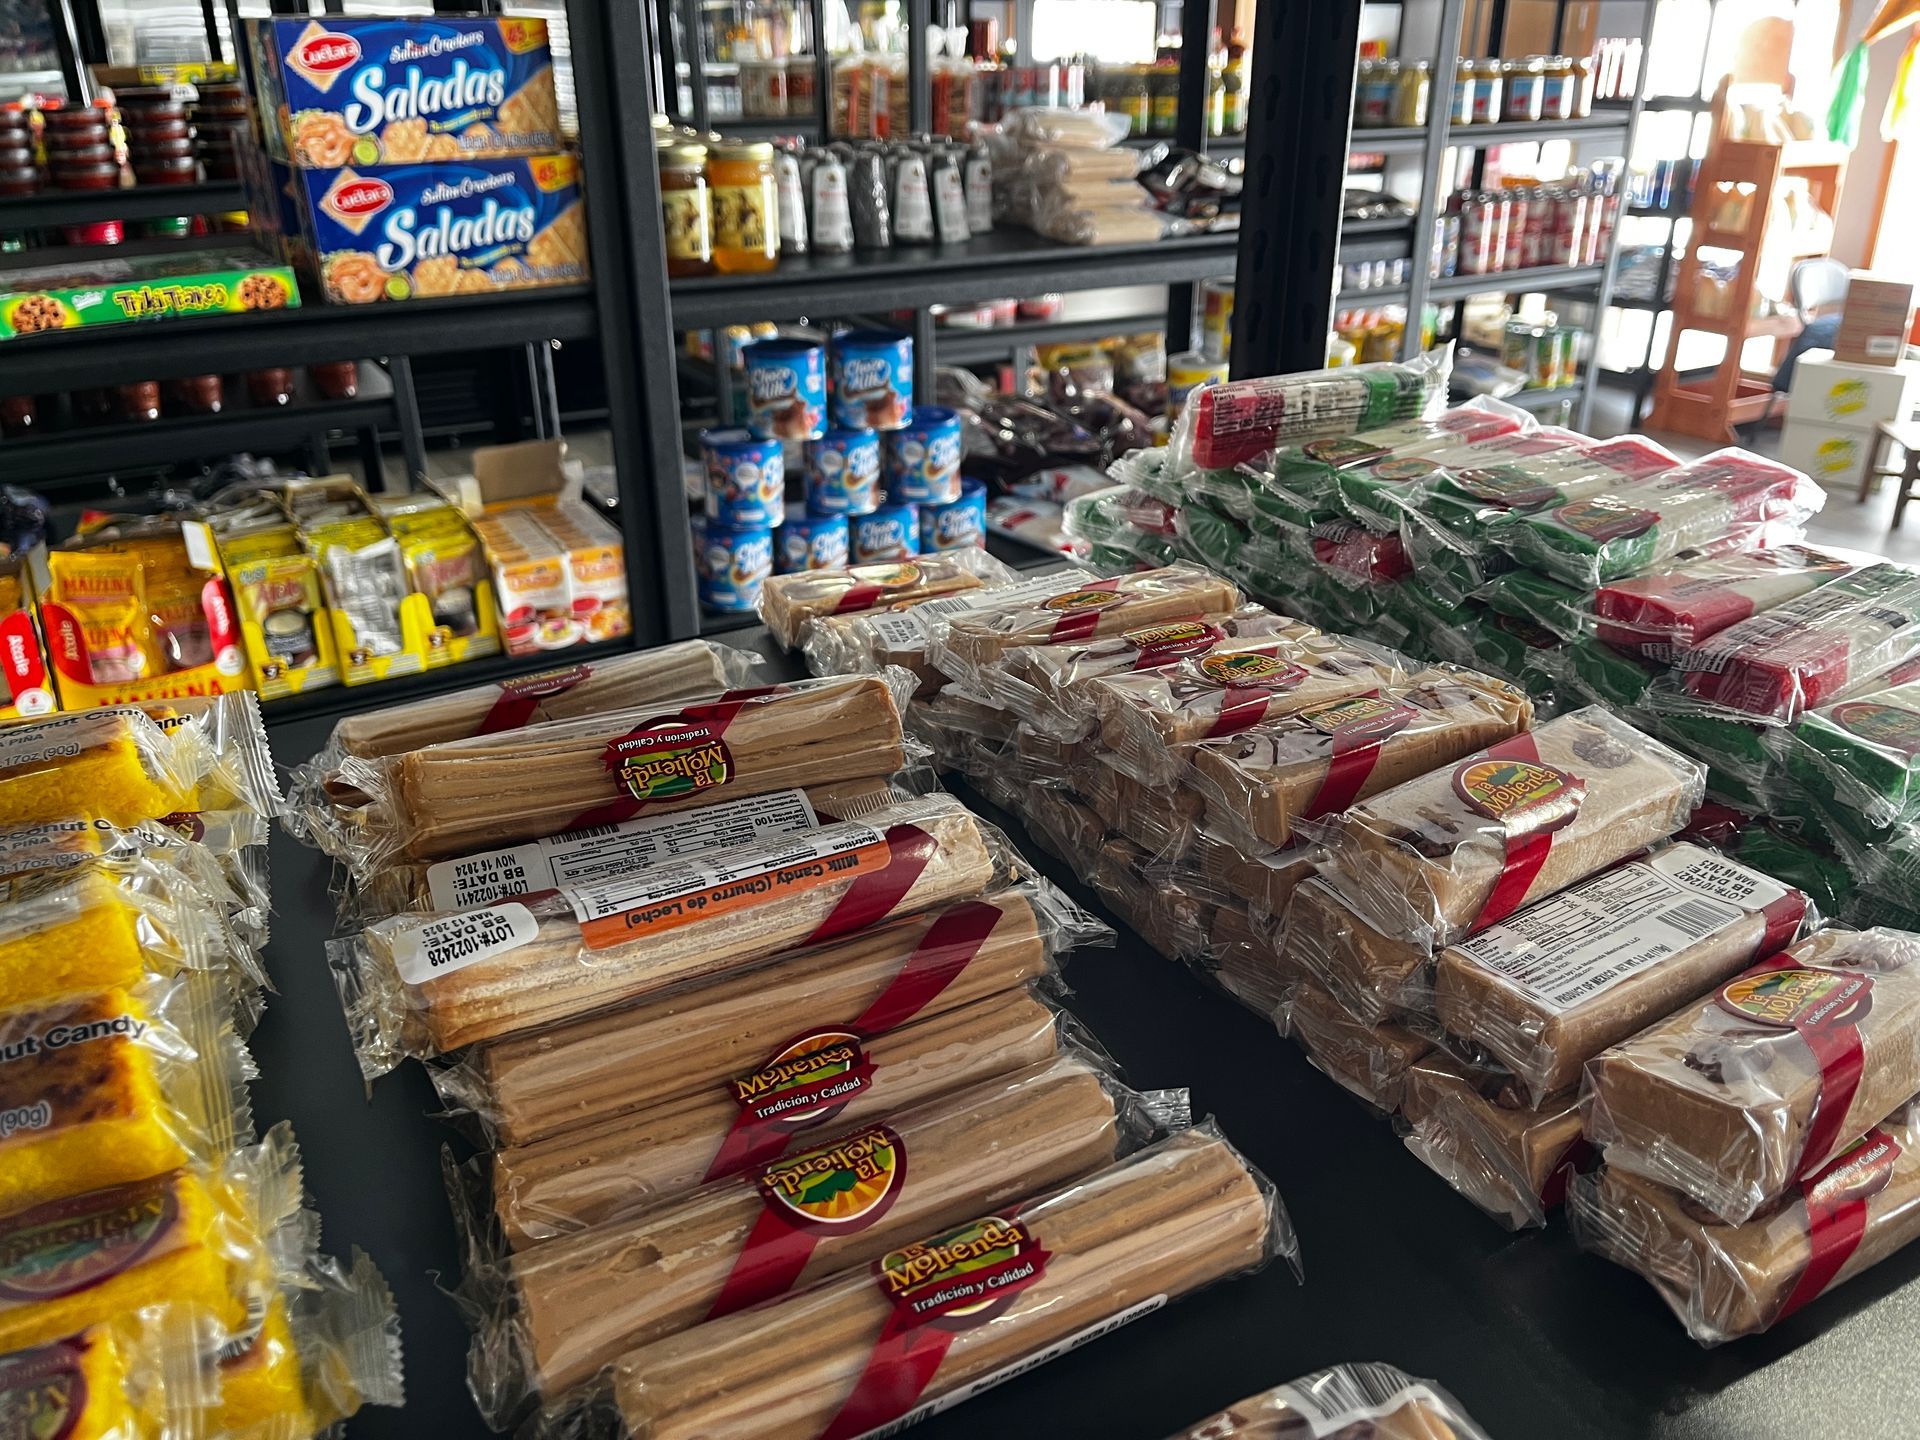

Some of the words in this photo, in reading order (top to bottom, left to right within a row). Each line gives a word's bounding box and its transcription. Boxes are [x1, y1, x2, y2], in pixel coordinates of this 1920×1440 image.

[345, 59, 505, 134] Saladas
[377, 199, 535, 271] Saladas
[7, 634, 30, 676] Atole
[1212, 656, 1284, 683] Molienda
[617, 736, 655, 752] Calidad
[656, 734, 663, 744] y
[664, 727, 712, 743] Tradición
[43, 742, 79, 760] (90g)
[620, 745, 727, 790] Molienda
[694, 768, 715, 787] La
[1474, 781, 1497, 796] La
[1481, 768, 1560, 816] Molienda
[754, 815, 773, 826] 100
[773, 812, 804, 823] Calories
[831, 834, 876, 852] Nutrition
[454, 861, 478, 877] 2024
[480, 858, 492, 871] 16
[494, 853, 515, 868] NOV
[826, 853, 859, 873] Milk
[1697, 857, 1724, 875] 2025
[452, 871, 498, 890] DATE:
[503, 866, 524, 879] BB
[773, 860, 824, 887] Candy
[1684, 862, 1730, 888] DATE:
[1734, 872, 1759, 888] MAR
[455, 879, 528, 906] LOT#:1022411
[710, 874, 772, 904] (Churro
[1731, 881, 1754, 896] BB
[685, 895, 707, 910] de
[451, 916, 465, 928] 13
[466, 907, 493, 924] MAR
[481, 913, 506, 929] BB
[623, 899, 683, 929] Leche)
[421, 921, 449, 938] 2025
[421, 922, 476, 950] DATE:
[426, 921, 515, 967] LOT#:1022428
[1464, 937, 1488, 949] Facts
[1612, 962, 1631, 972] NET
[1580, 981, 1597, 990] OF
[1587, 968, 1620, 985] MEXICO
[1552, 985, 1588, 1003] PRODUCT
[1743, 993, 1769, 1007] La
[1758, 970, 1831, 1024] Molienda
[45, 1016, 147, 1049] Candy
[754, 1093, 810, 1119] Tradición
[810, 1093, 819, 1103] y
[820, 1077, 862, 1099] Calidad
[0, 1101, 49, 1136] (90g)
[762, 1130, 893, 1195] Molienda
[1858, 1142, 1889, 1166] Calidad
[856, 1156, 884, 1180] La
[886, 1222, 1024, 1292] Molienda
[911, 1283, 975, 1313] Tradición
[975, 1281, 985, 1294] y
[986, 1262, 1035, 1289] Calidad
